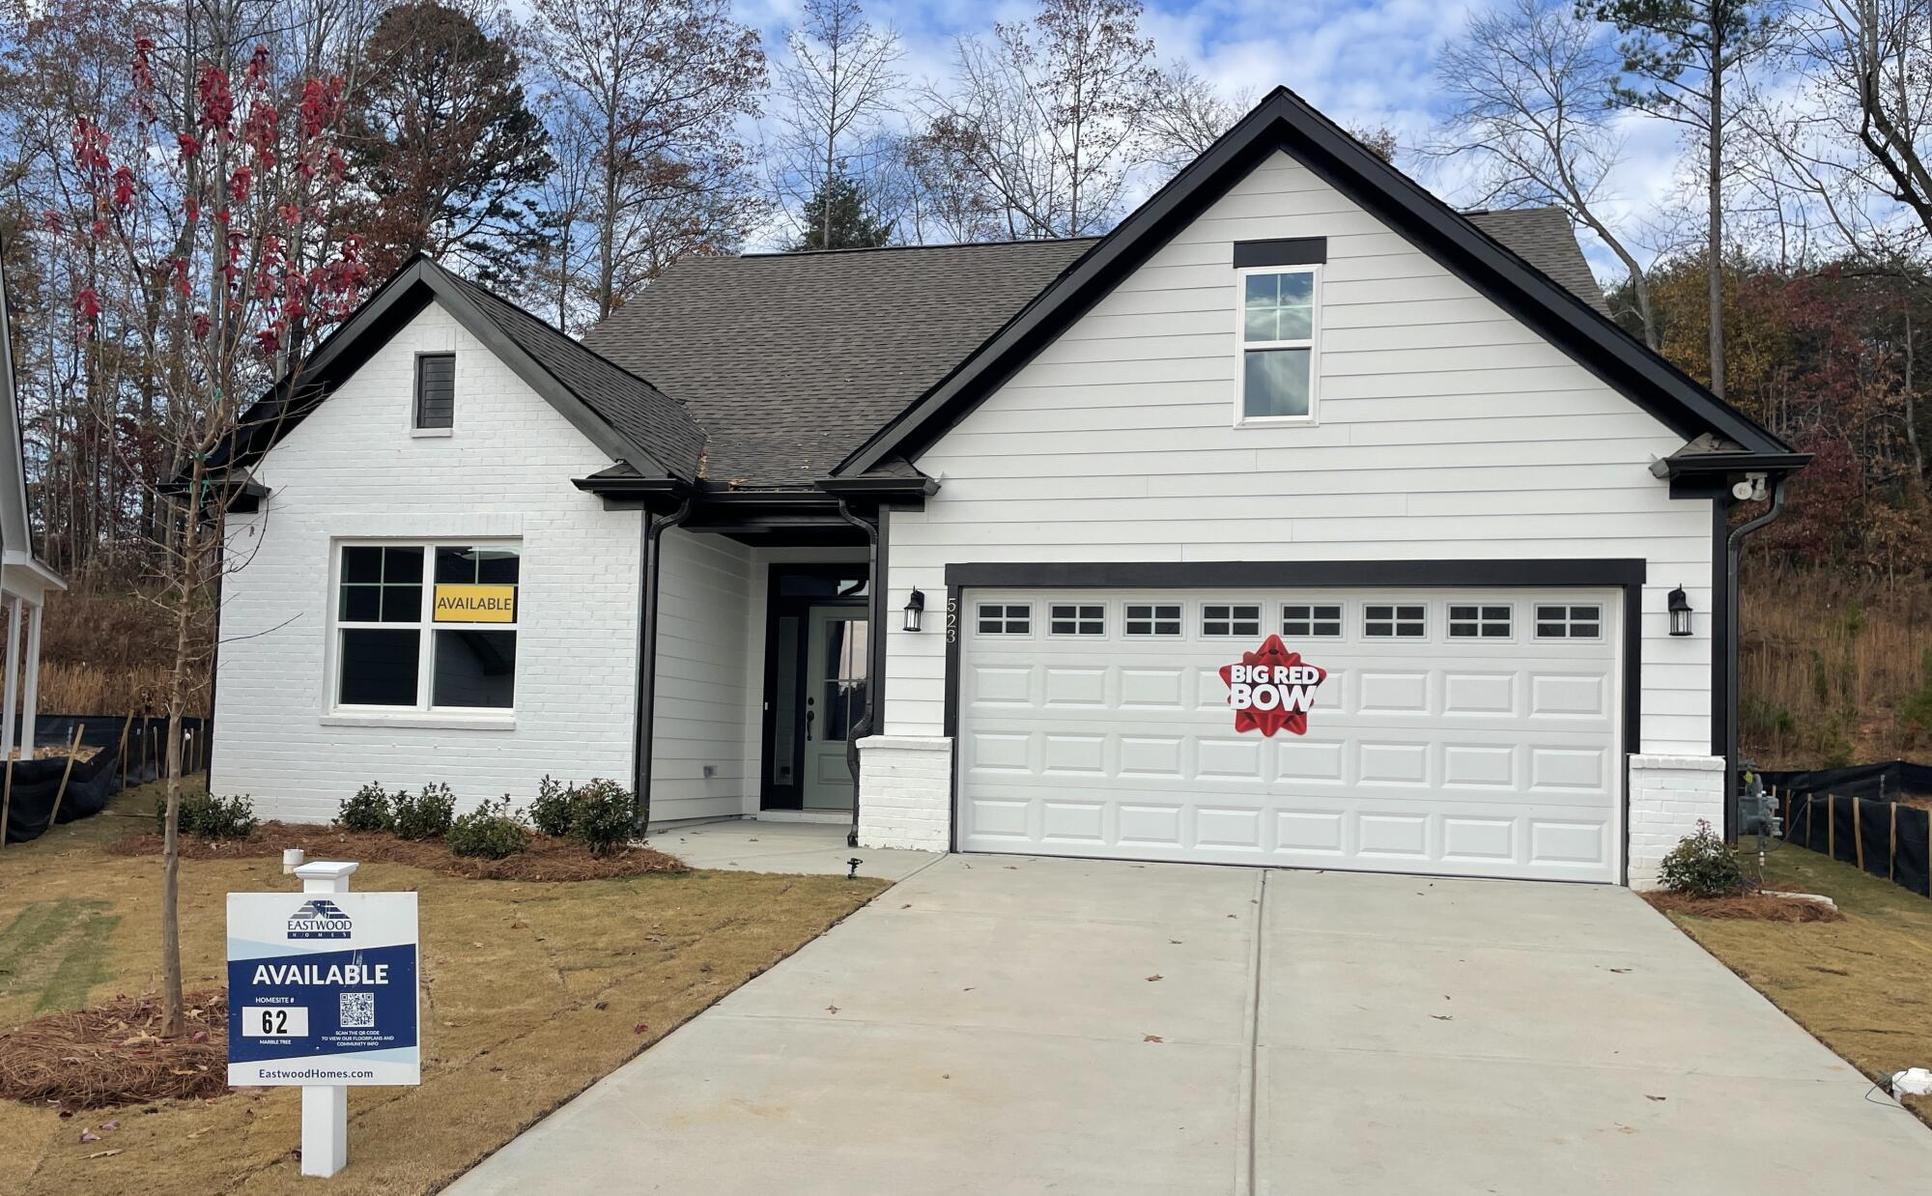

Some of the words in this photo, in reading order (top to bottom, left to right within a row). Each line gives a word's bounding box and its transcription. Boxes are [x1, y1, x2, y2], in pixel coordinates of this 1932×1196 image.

[437, 597, 512, 611] AVAILABLE
[946, 597, 956, 644] 523
[1231, 665, 1269, 684] BIG
[1274, 666, 1320, 685] RED
[1230, 683, 1317, 712] BOW
[287, 920, 352, 931] EASTWOOD
[252, 964, 389, 985] AVAILABLE
[262, 1010, 288, 1034] 62
[258, 1069, 373, 1079] EastwoodHomes.com
